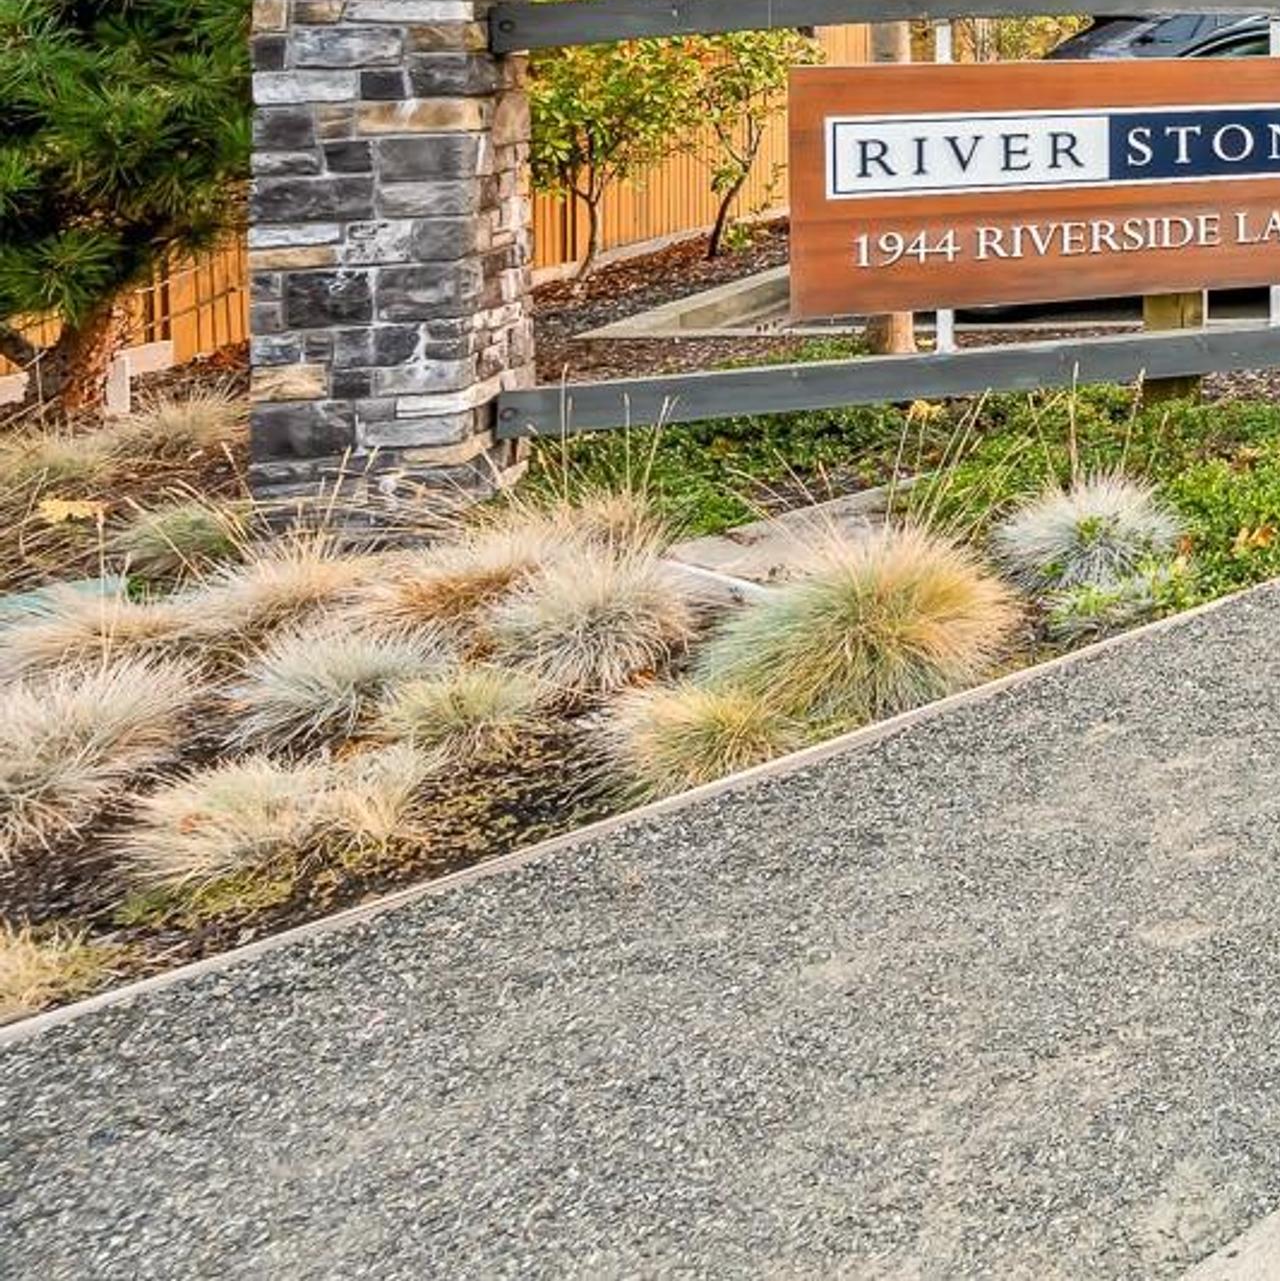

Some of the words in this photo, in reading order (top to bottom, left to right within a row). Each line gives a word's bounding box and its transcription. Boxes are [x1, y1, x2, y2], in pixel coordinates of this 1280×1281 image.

[856, 131, 1084, 178] RIVER
[853, 228, 961, 268] 1944
[975, 214, 1221, 260] RIVERSIDE
